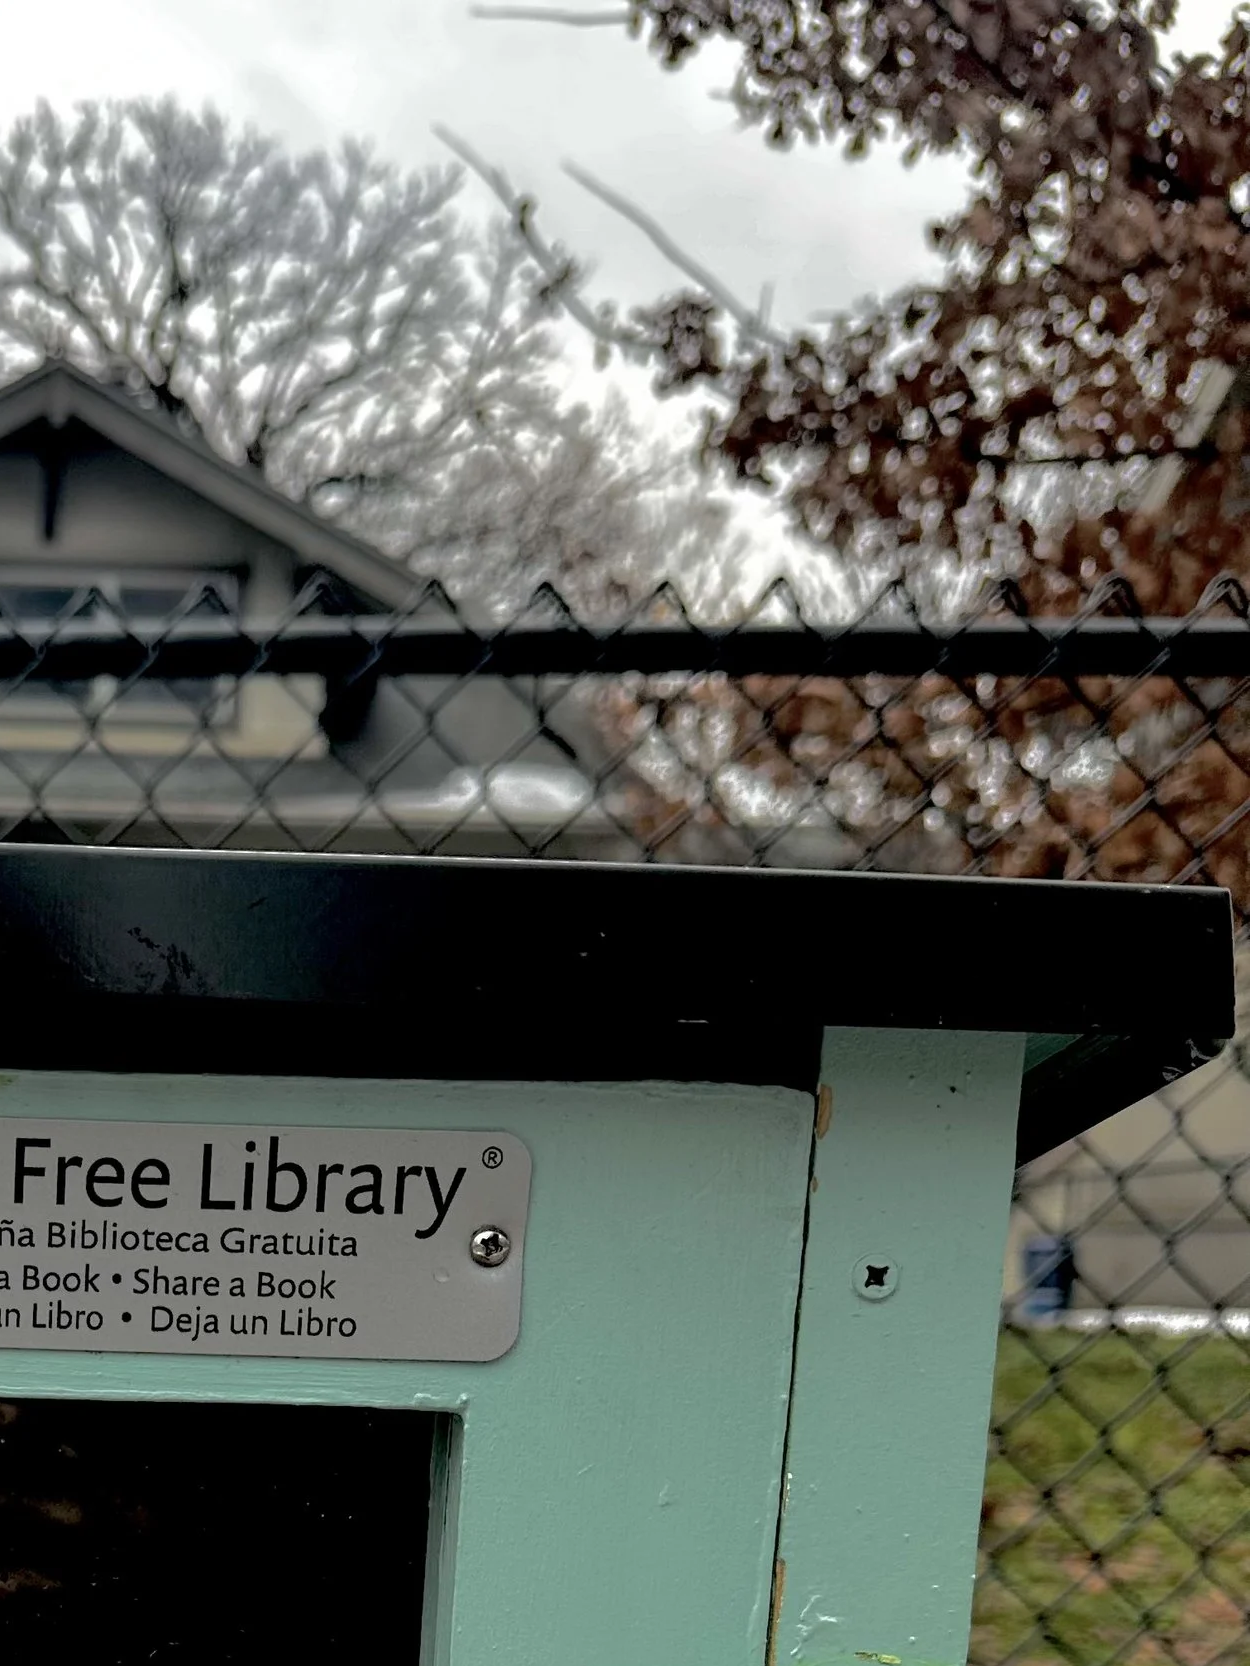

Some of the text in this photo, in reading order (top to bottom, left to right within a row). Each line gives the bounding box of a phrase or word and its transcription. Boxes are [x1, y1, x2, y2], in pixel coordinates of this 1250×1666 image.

[14, 1137, 171, 1209] Free
[200, 1136, 467, 1239] Library
[47, 1219, 210, 1252] Biblioteca
[220, 1227, 358, 1256] Gratuita
[22, 1264, 101, 1292] Book
[132, 1265, 220, 1296] Share
[229, 1277, 246, 1298] a
[256, 1270, 337, 1300] Book
[32, 1300, 104, 1330] Libro
[150, 1306, 219, 1342] Deja
[230, 1313, 268, 1335] un
[280, 1307, 358, 1337] Libro
